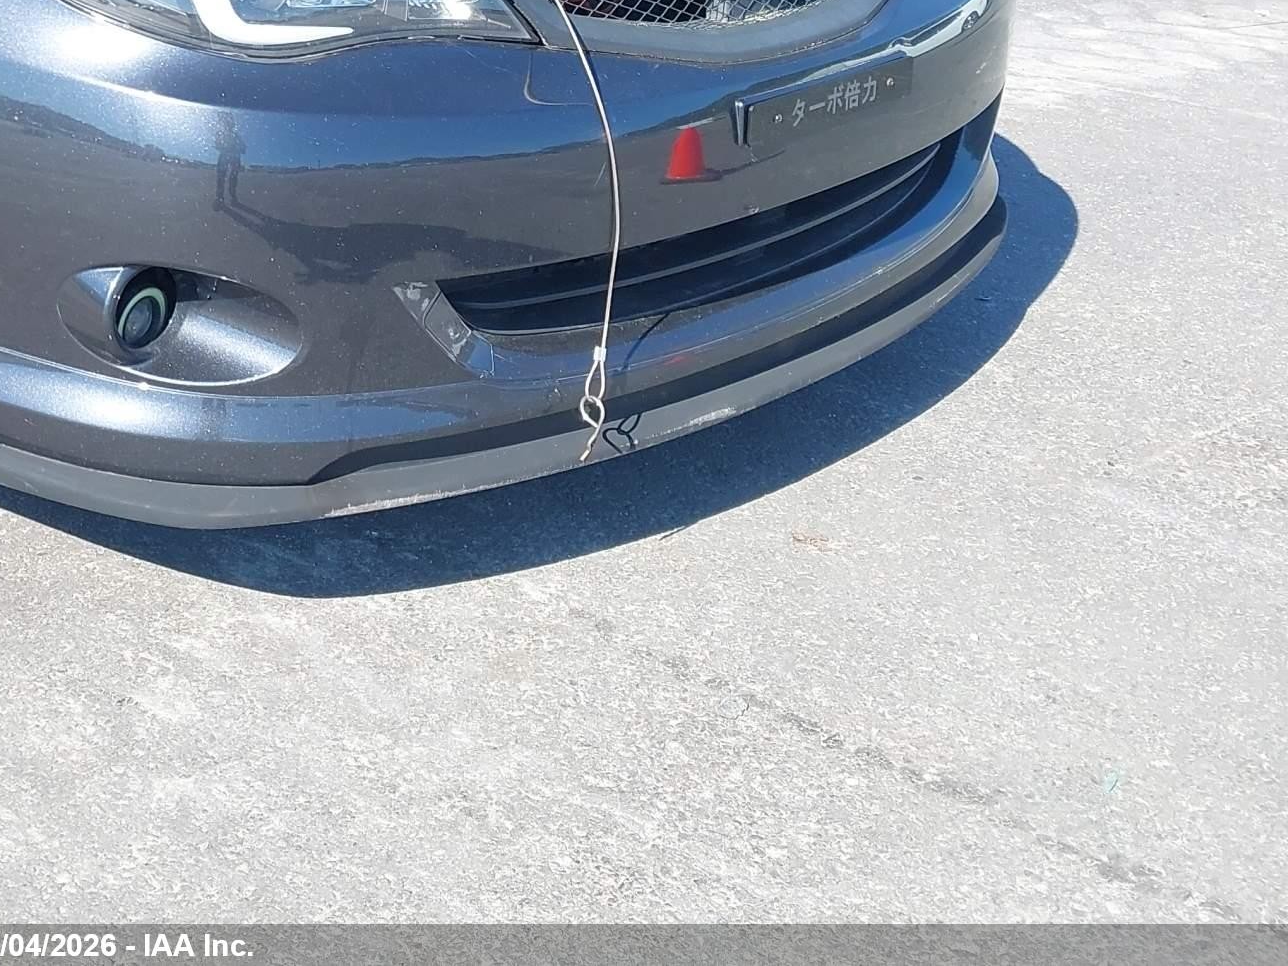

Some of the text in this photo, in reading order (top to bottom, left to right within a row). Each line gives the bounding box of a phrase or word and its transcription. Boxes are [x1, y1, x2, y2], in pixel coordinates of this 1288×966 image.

[792, 75, 877, 127] ターボ倍力
